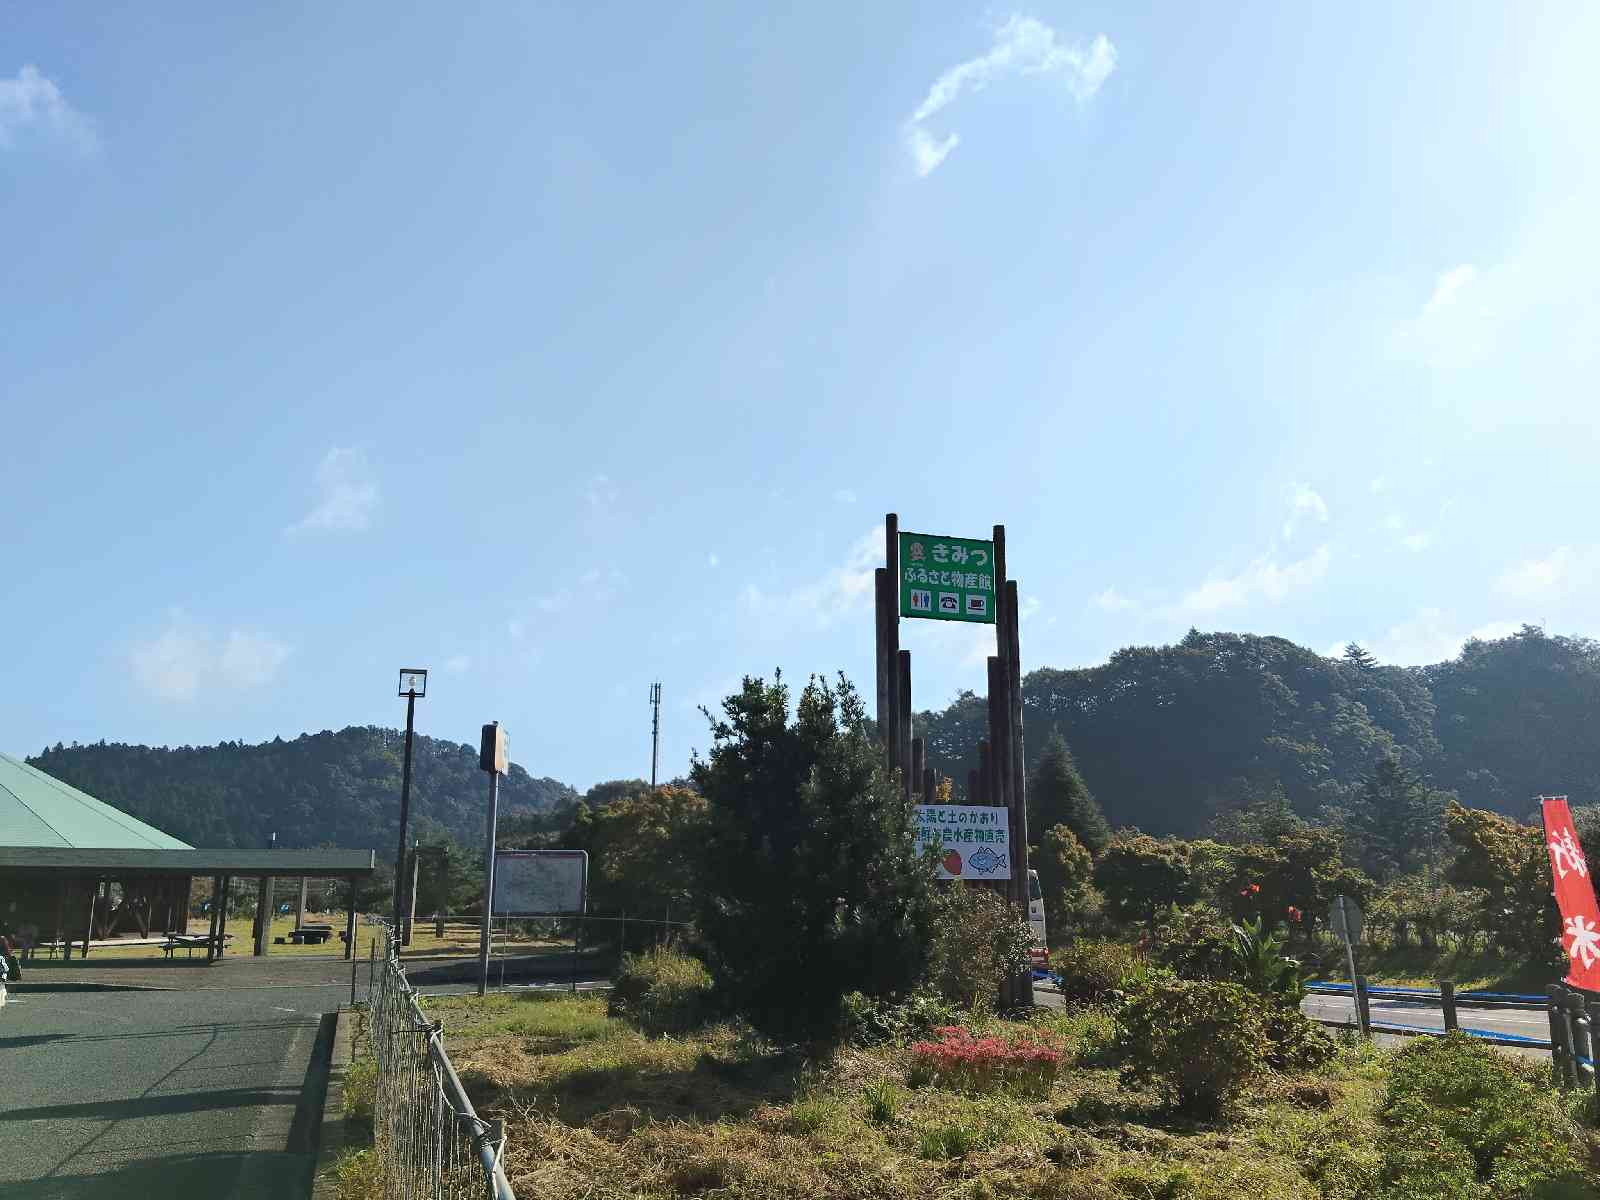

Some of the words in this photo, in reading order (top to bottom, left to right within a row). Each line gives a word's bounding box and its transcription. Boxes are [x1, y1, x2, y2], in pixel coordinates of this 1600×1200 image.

[932, 543, 988, 566] きみつ
[904, 567, 992, 591] ふるさと物産館
